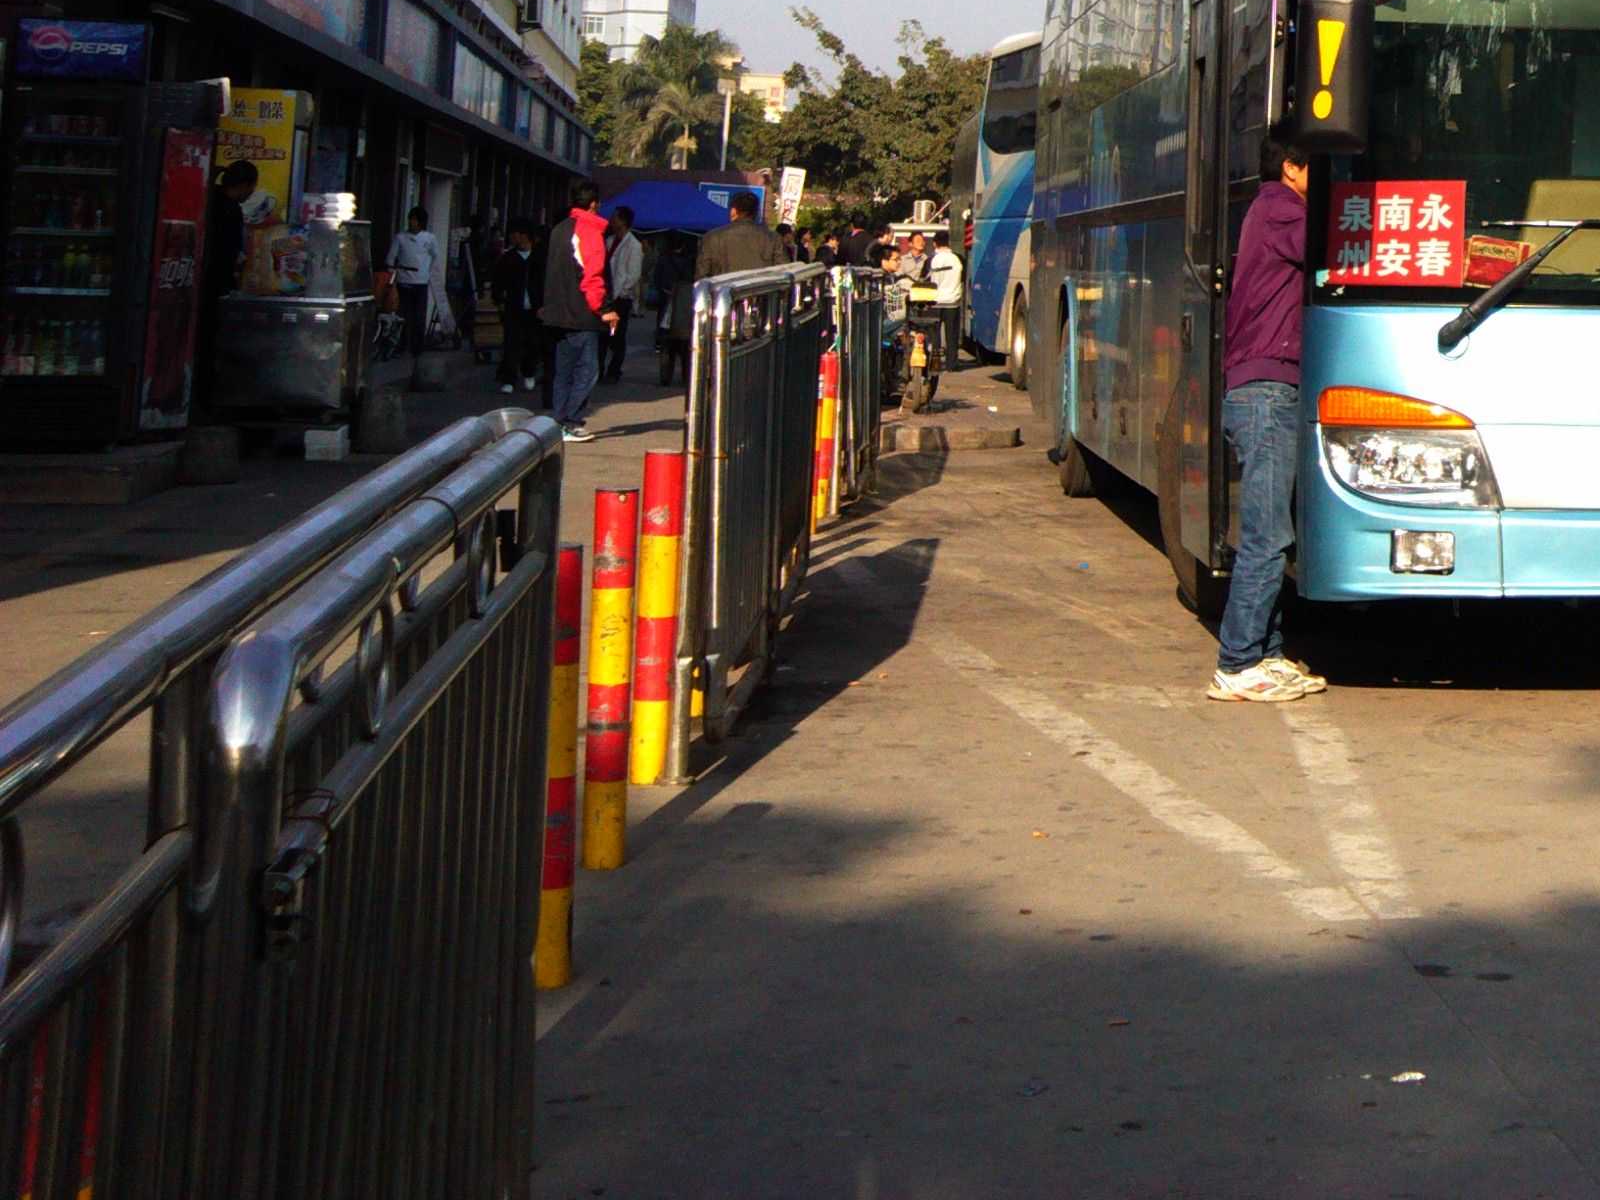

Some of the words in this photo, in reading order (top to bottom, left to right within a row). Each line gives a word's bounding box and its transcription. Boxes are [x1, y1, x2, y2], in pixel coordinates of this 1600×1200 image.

[68, 41, 129, 56] PEPSI
[1338, 195, 1373, 277] 泉州
[1376, 194, 1414, 277] 南安
[1414, 193, 1453, 277] 永春
